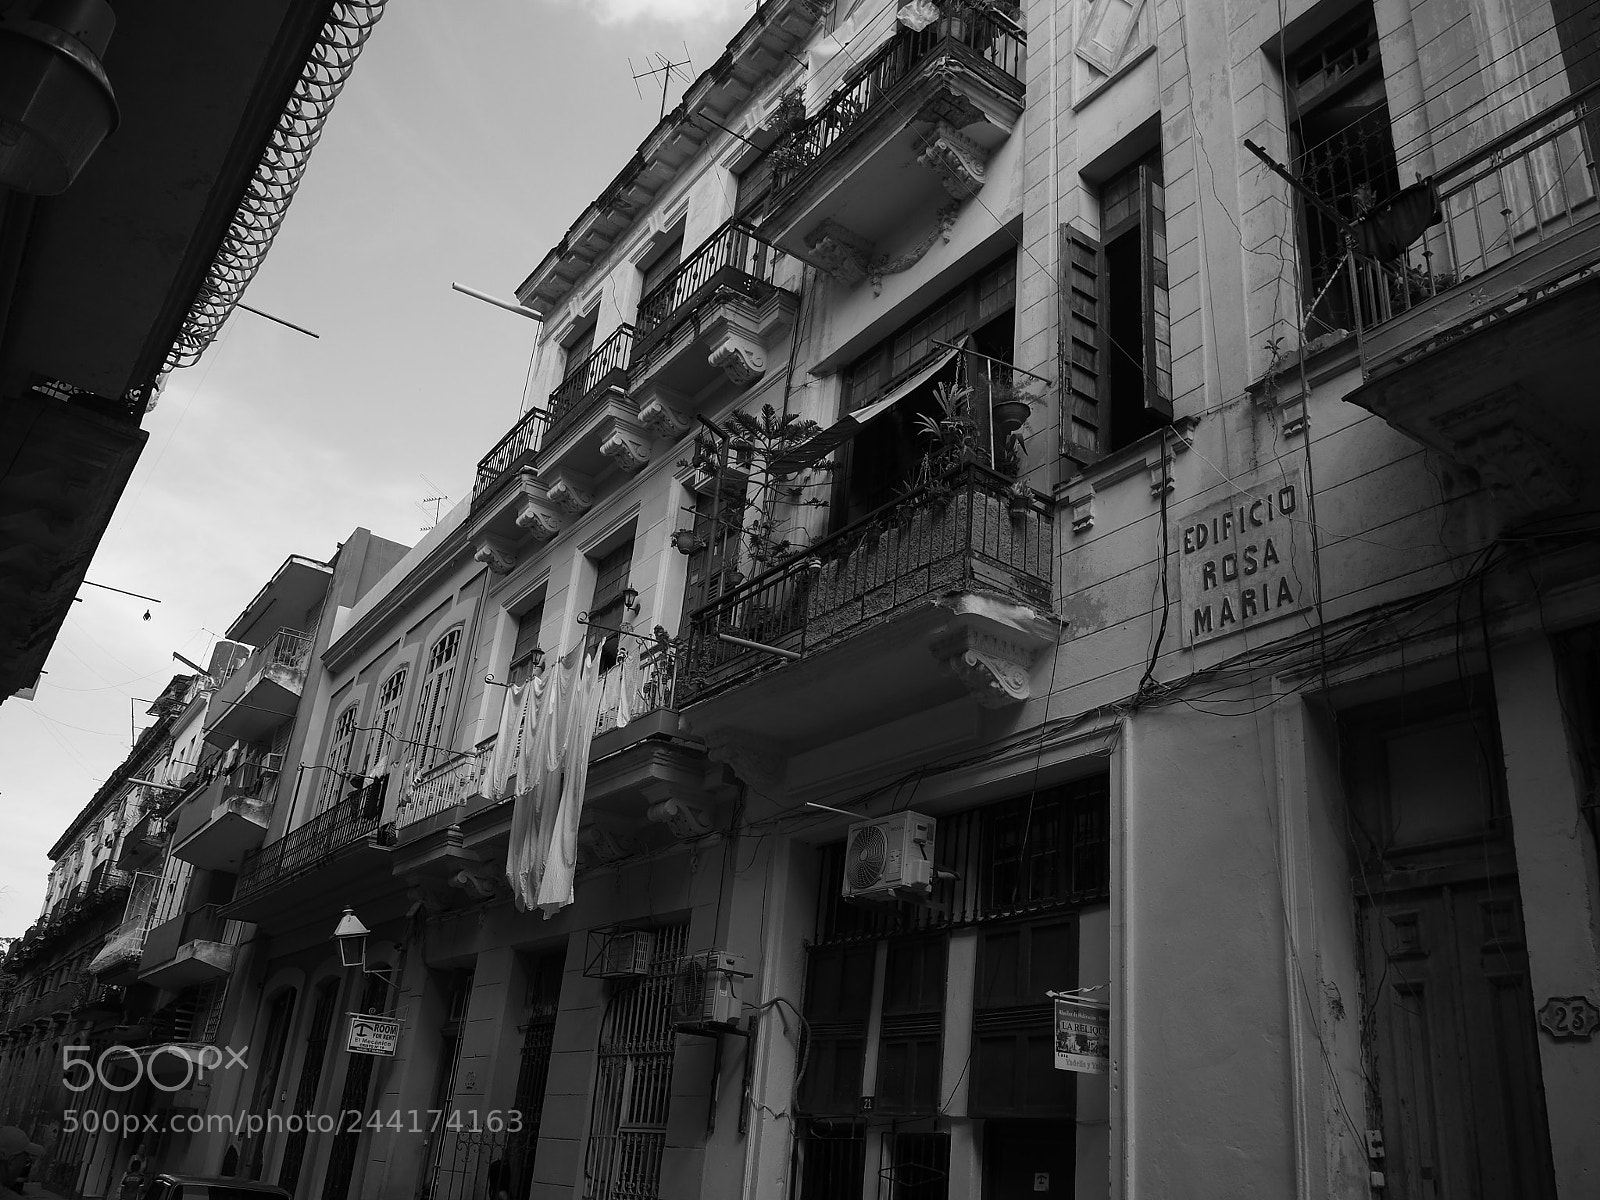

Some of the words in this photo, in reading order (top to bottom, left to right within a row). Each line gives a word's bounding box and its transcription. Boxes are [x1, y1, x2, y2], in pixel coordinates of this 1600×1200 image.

[1185, 485, 1296, 555] EDIFICIO
[1203, 538, 1280, 591] ROSA
[1194, 576, 1294, 637] MARIA
[374, 1024, 397, 1035] ROOM
[1062, 1021, 1073, 1031] LA
[1074, 1023, 1108, 1037] RELIQUI
[1555, 1006, 1585, 1031] 23
